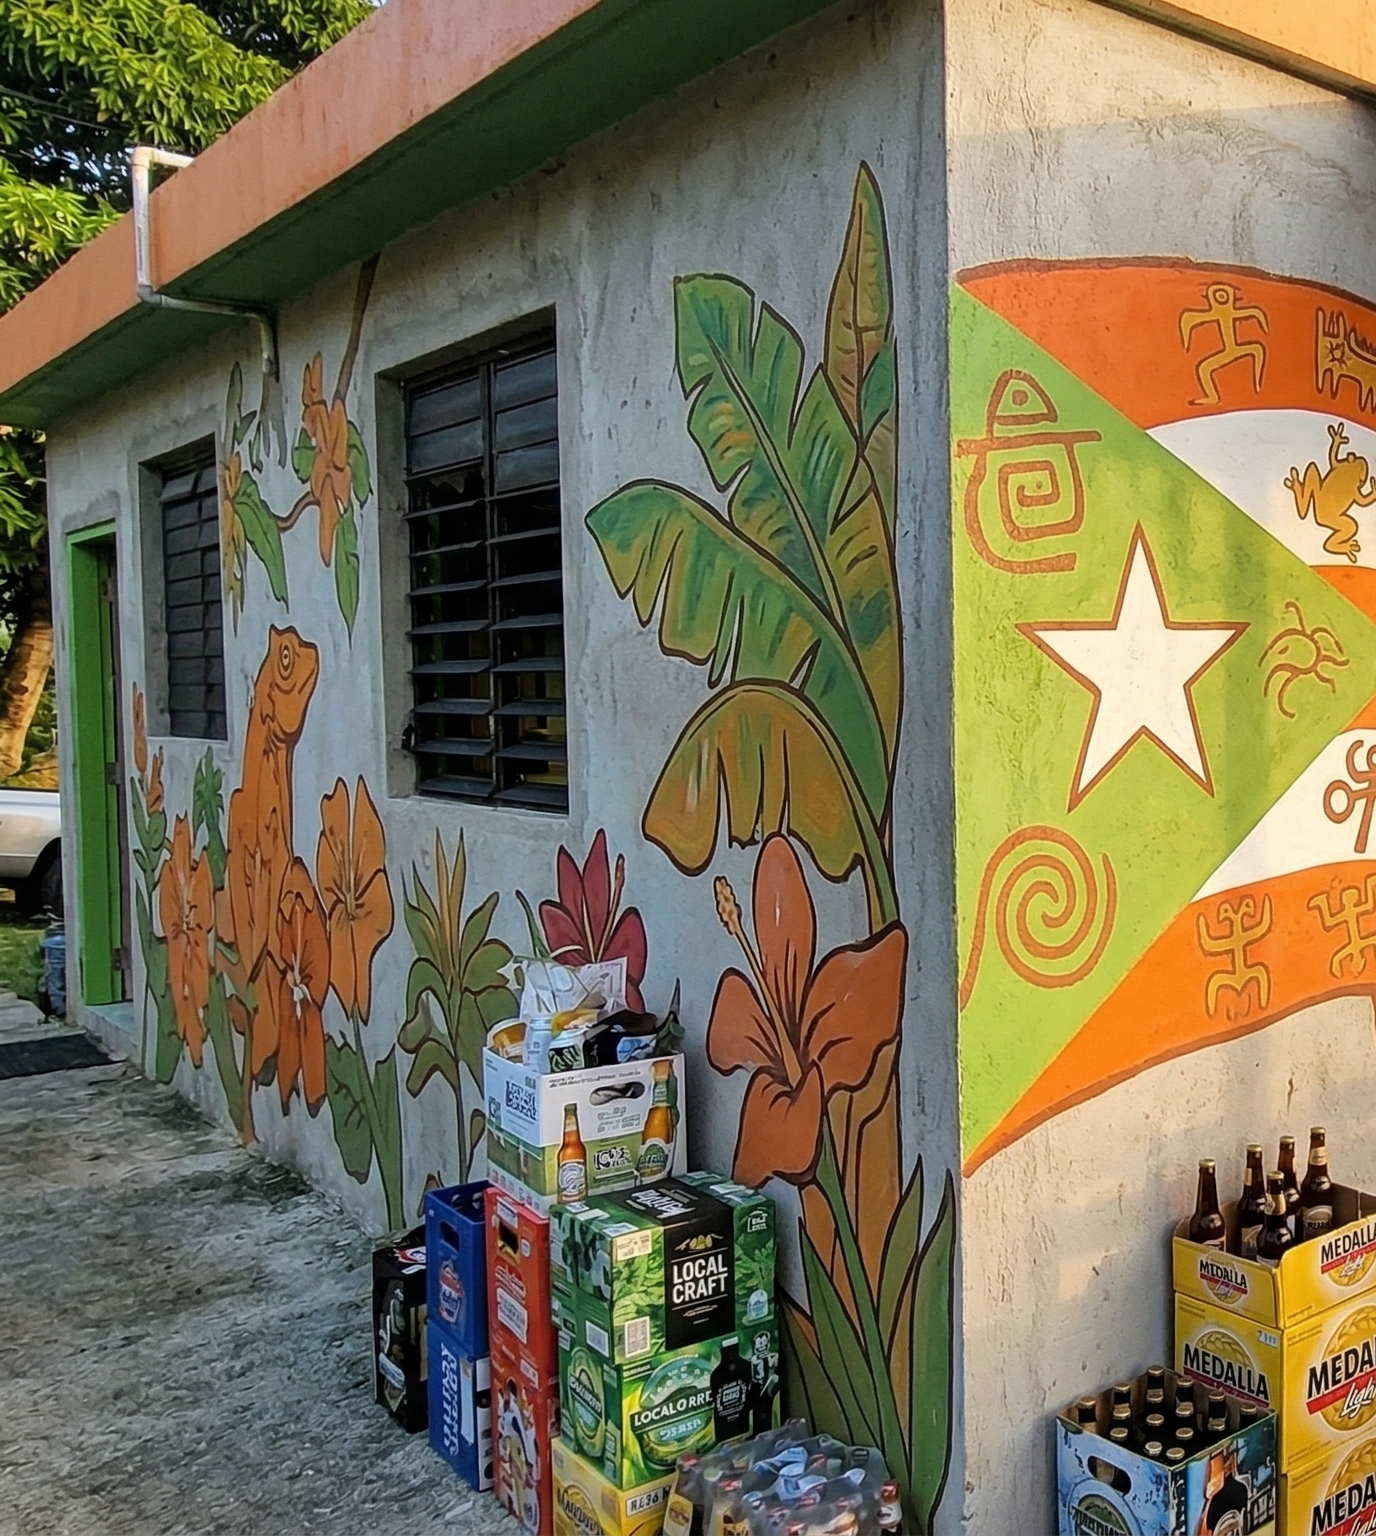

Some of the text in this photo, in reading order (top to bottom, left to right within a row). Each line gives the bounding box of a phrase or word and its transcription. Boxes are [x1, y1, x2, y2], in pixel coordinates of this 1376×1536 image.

[673, 1254, 728, 1284] LOCAL
[672, 1273, 728, 1304] CRAFT
[1183, 1344, 1270, 1401] MEDALLA
